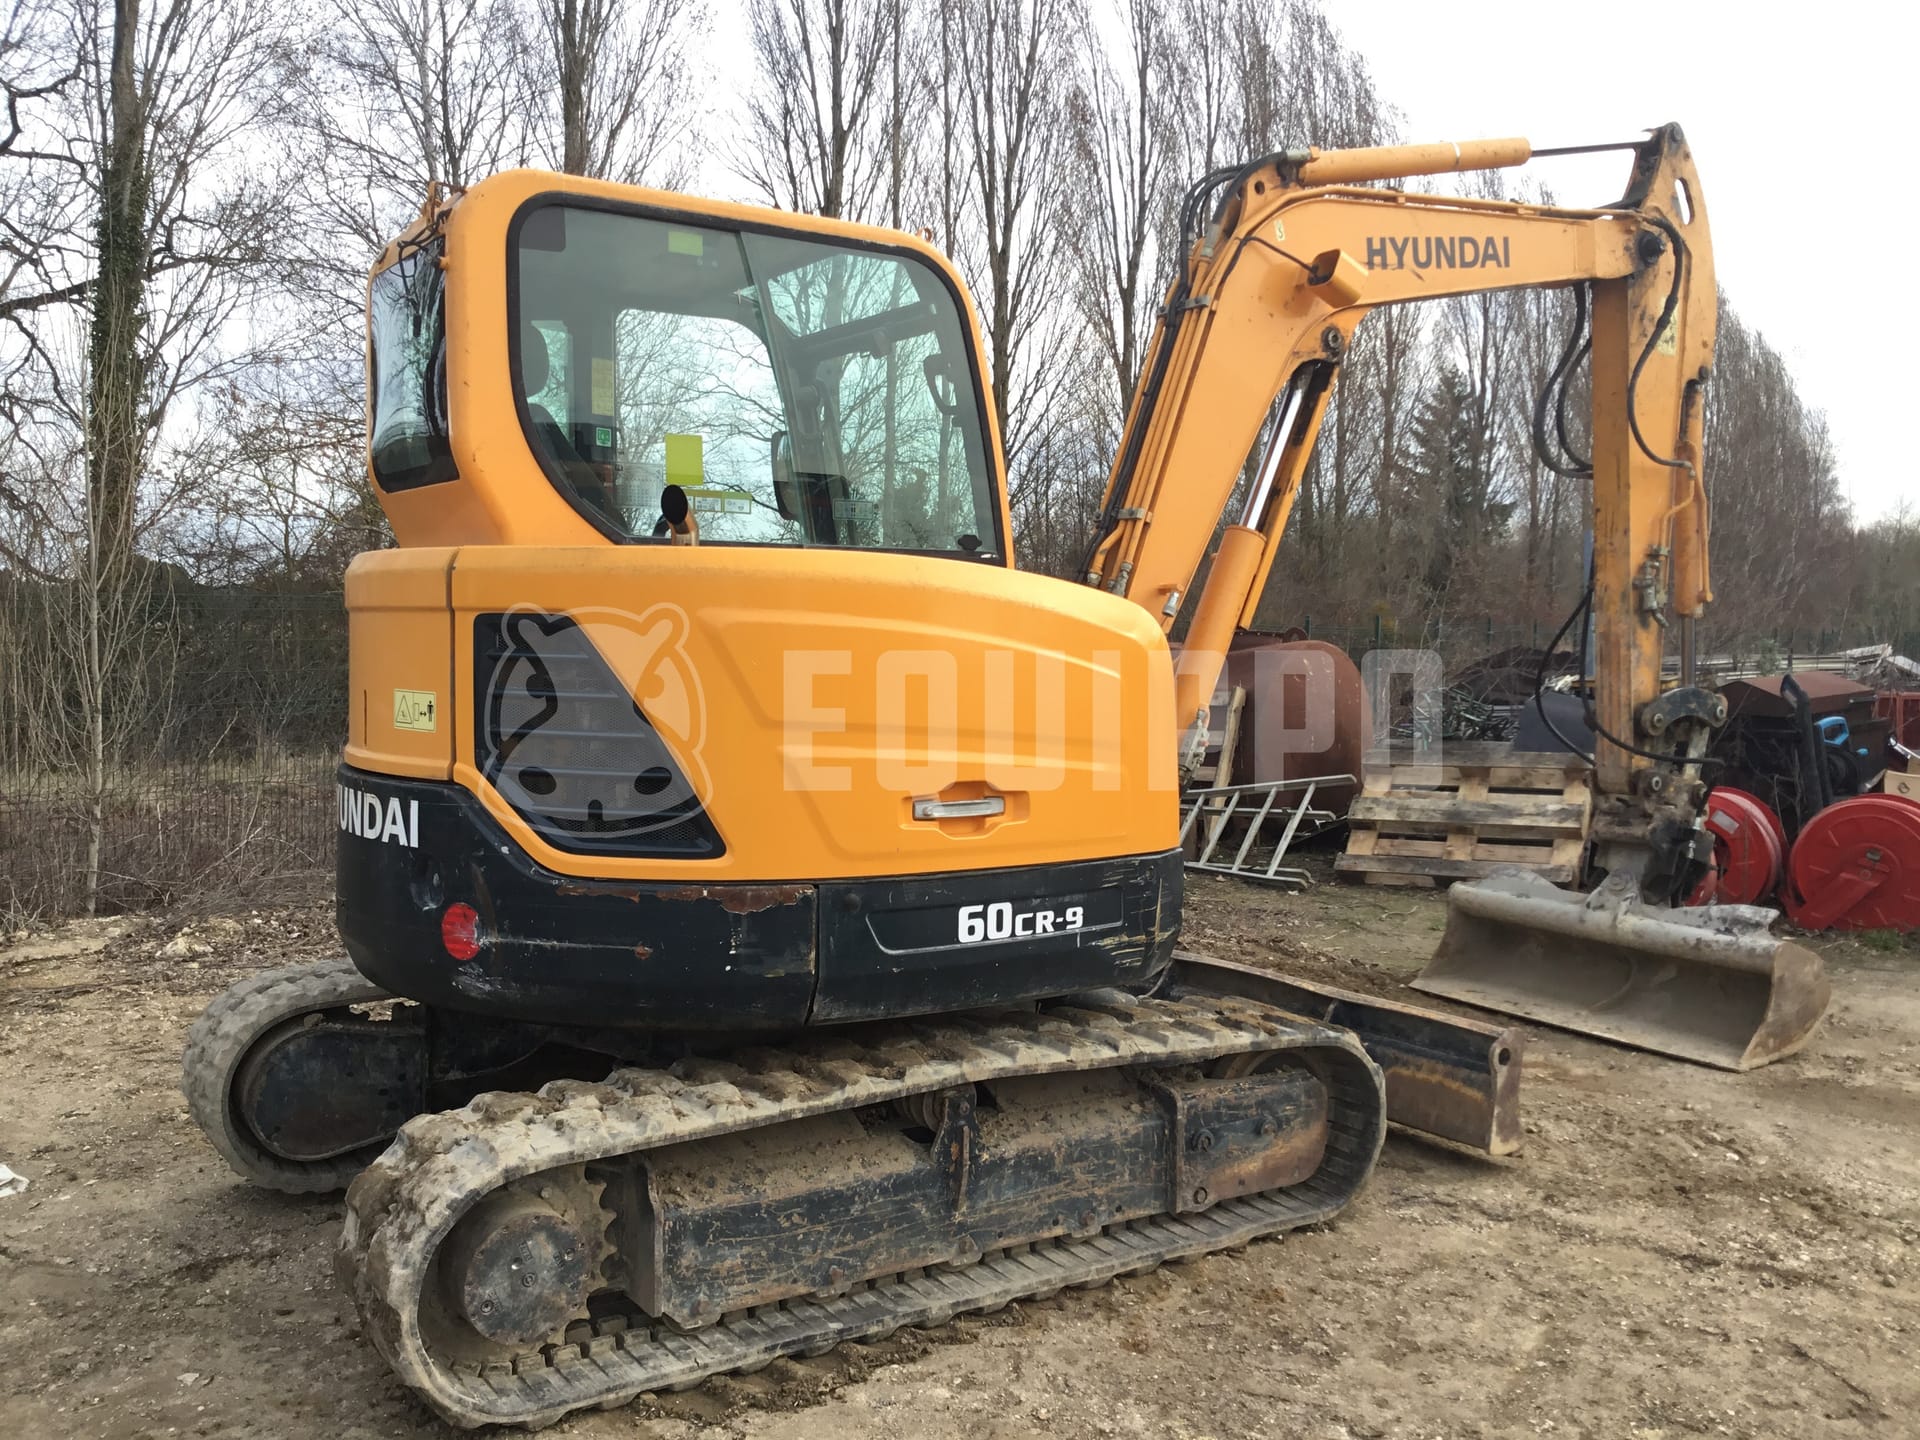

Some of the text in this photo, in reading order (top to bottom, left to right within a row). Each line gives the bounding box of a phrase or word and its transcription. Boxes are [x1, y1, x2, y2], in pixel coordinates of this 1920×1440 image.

[1366, 236, 1510, 270] HYUNDAI
[337, 783, 419, 848] UNDAI
[958, 901, 1083, 943] 60CR-9
